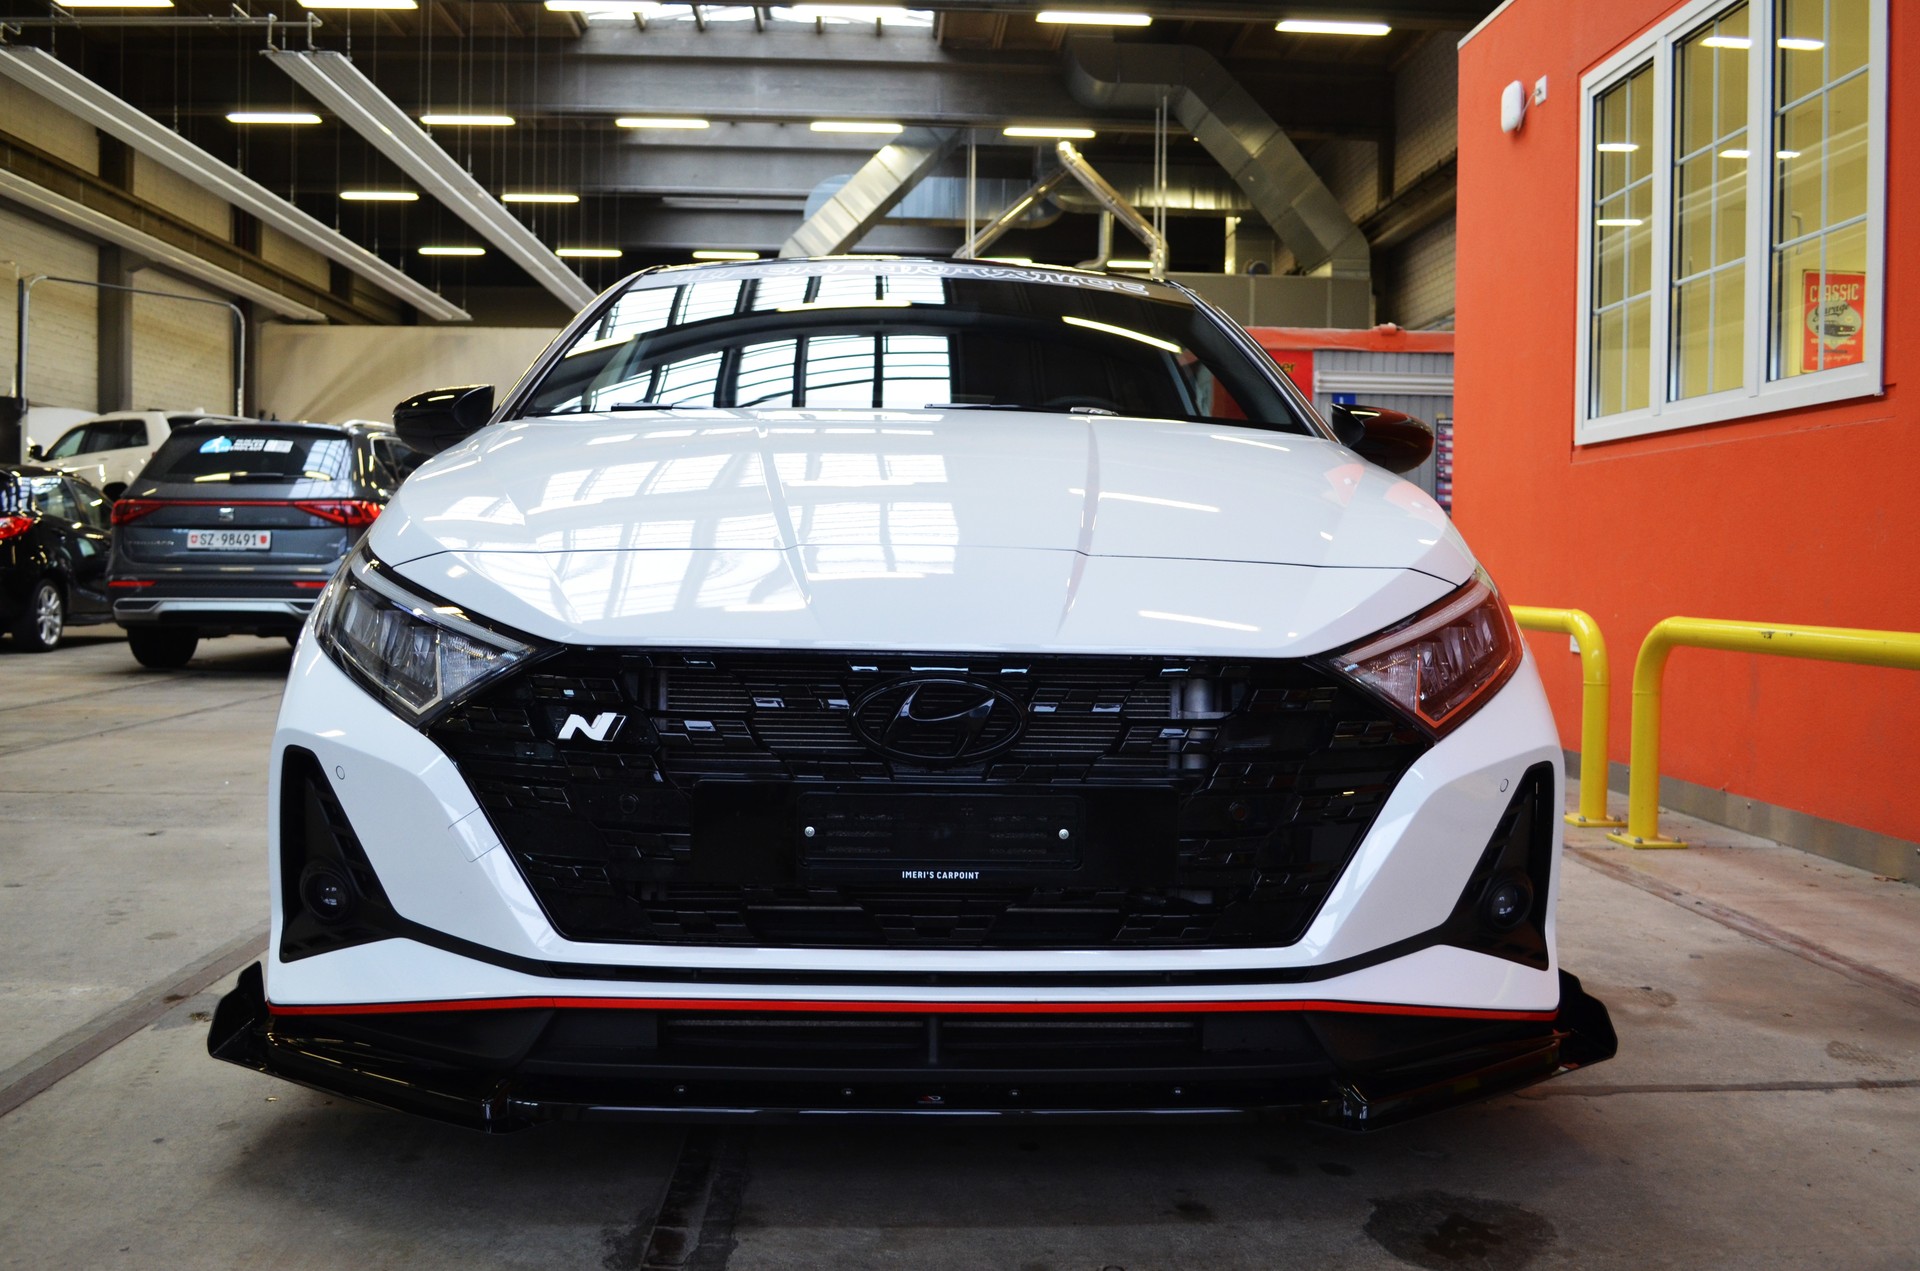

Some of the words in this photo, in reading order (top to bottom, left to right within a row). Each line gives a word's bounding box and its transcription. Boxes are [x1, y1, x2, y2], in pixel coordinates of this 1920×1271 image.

[557, 712, 626, 742] N
[902, 871, 935, 880] IMERI'S
[936, 871, 980, 881] CARPOINT
